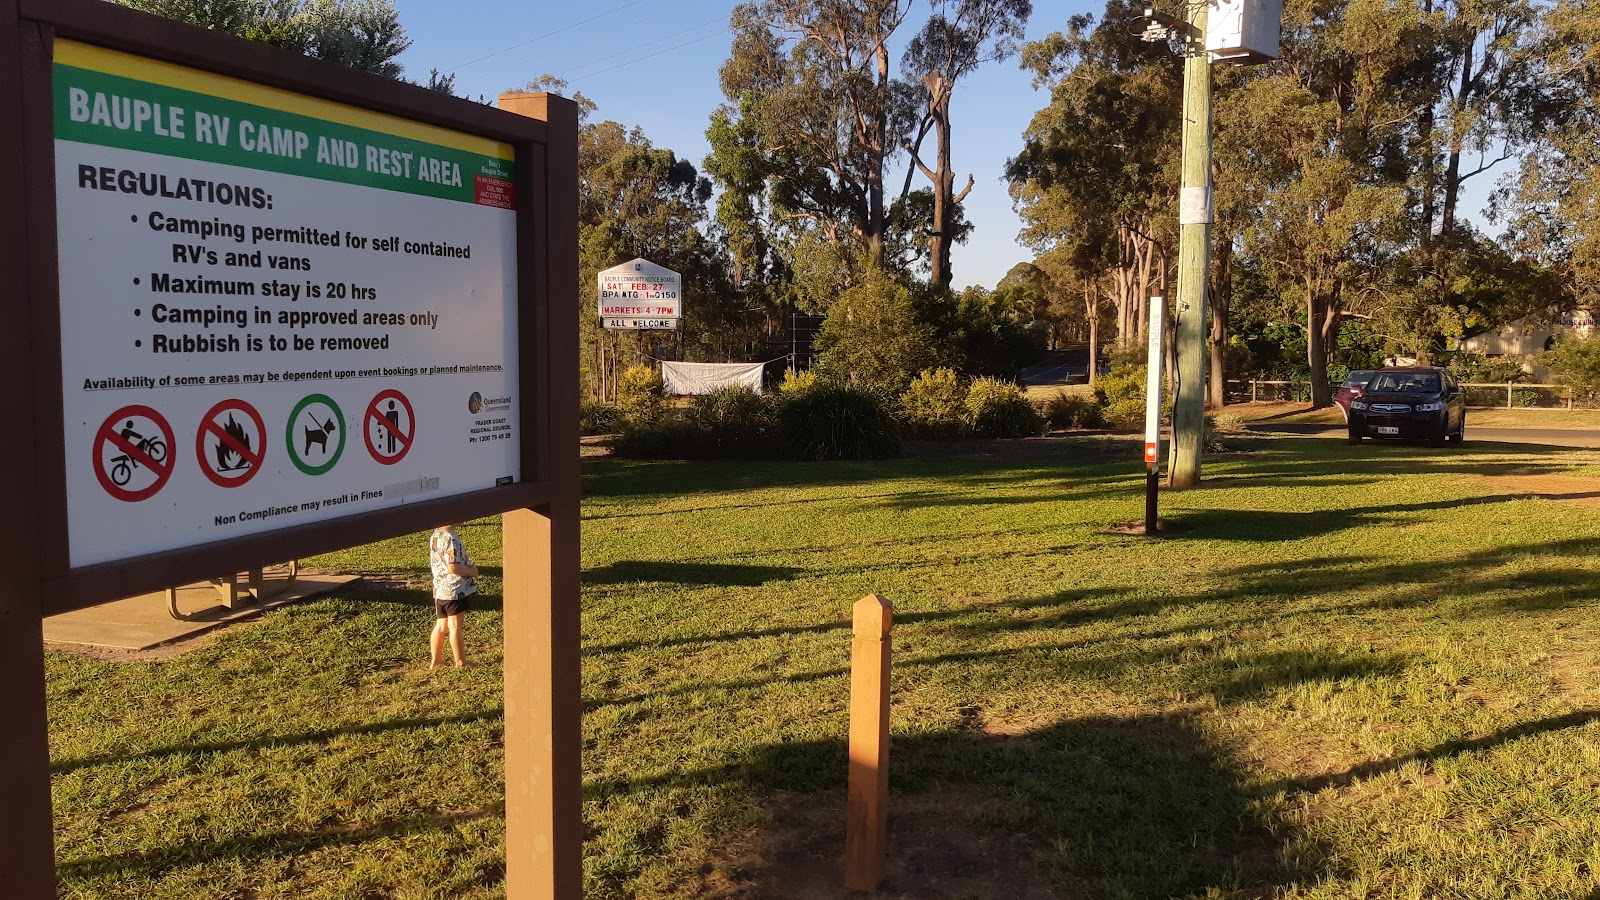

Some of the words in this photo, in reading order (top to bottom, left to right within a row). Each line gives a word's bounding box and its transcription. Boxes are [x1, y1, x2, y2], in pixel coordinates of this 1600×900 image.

[69, 86, 186, 140] BAUPLE
[194, 110, 230, 146] RV
[239, 120, 309, 160] CAMP
[316, 136, 358, 168] AND
[366, 145, 413, 178] REST
[418, 156, 462, 188] AREA
[78, 164, 272, 210] REGULATIONS:
[148, 211, 245, 243] Camping
[252, 226, 340, 247] permitted
[344, 232, 367, 249] for
[372, 236, 400, 252] self
[404, 241, 471, 259] contained
[172, 244, 218, 265] RV's
[225, 251, 262, 268] and
[268, 255, 311, 271] vans
[151, 272, 255, 295] Maximum
[261, 280, 300, 301] stay
[306, 281, 320, 298] is
[326, 282, 346, 299] 20
[351, 283, 377, 300] hrs
[152, 303, 247, 328] Camping
[254, 306, 272, 324] in
[278, 309, 358, 328] approved
[363, 312, 405, 326] areas
[410, 311, 438, 329] only
[1152, 313, 1160, 348] BAUPLE
[152, 334, 240, 353] Rubbish
[247, 334, 263, 352] is
[269, 334, 287, 351] to
[294, 334, 315, 351] be
[320, 334, 389, 350] removed
[83, 376, 155, 390] Availability
[159, 375, 171, 386] of
[174, 376, 205, 386] some
[209, 374, 240, 384] areas
[243, 373, 264, 383] may
[267, 372, 280, 381] be
[282, 369, 332, 382] dependent
[335, 370, 355, 380] upon
[358, 368, 381, 377] event
[383, 366, 418, 376] bookings
[429, 365, 458, 375] planned
[460, 364, 504, 373] maintenance.
[484, 396, 511, 405] Queensland
[215, 514, 236, 526] Non
[239, 503, 298, 521] Compliance
[301, 500, 320, 512] may
[322, 494, 348, 507] result
[350, 493, 359, 502] in
[361, 489, 383, 500] Fines
